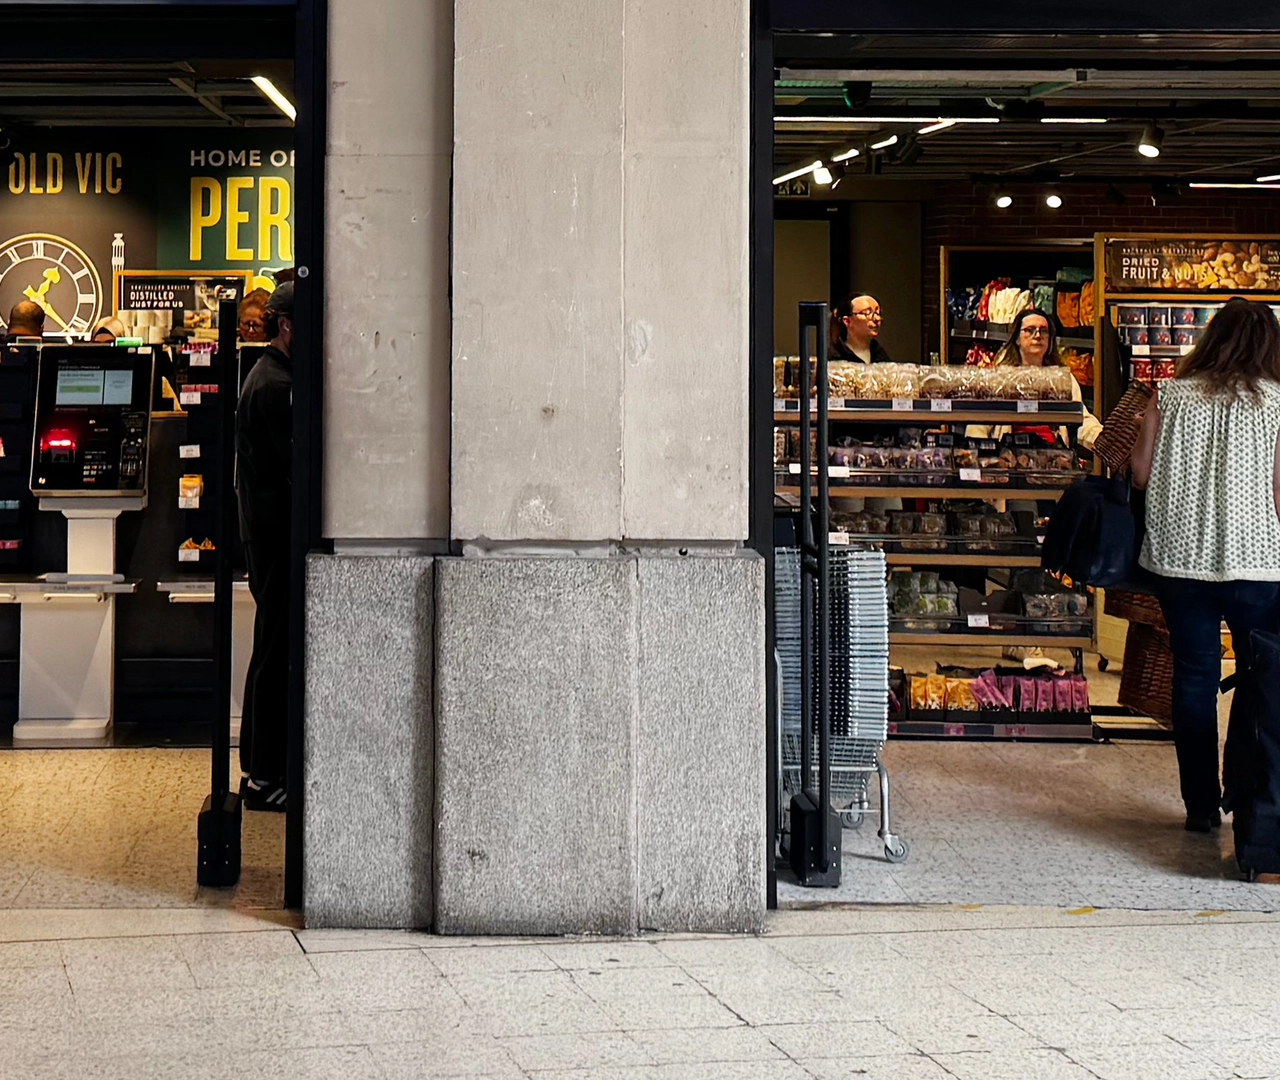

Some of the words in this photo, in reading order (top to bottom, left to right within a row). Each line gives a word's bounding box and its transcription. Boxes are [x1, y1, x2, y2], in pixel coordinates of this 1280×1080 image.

[190, 150, 262, 167] HOME
[8, 152, 63, 195] OLD
[75, 152, 122, 194] VIC
[189, 176, 293, 262] PER
[1122, 257, 1160, 266] DRIED
[1122, 267, 1159, 280] FRUIT
[1161, 267, 1170, 280] &
[1175, 267, 1208, 282] NUTS
[130, 291, 174, 301] DISTILLED
